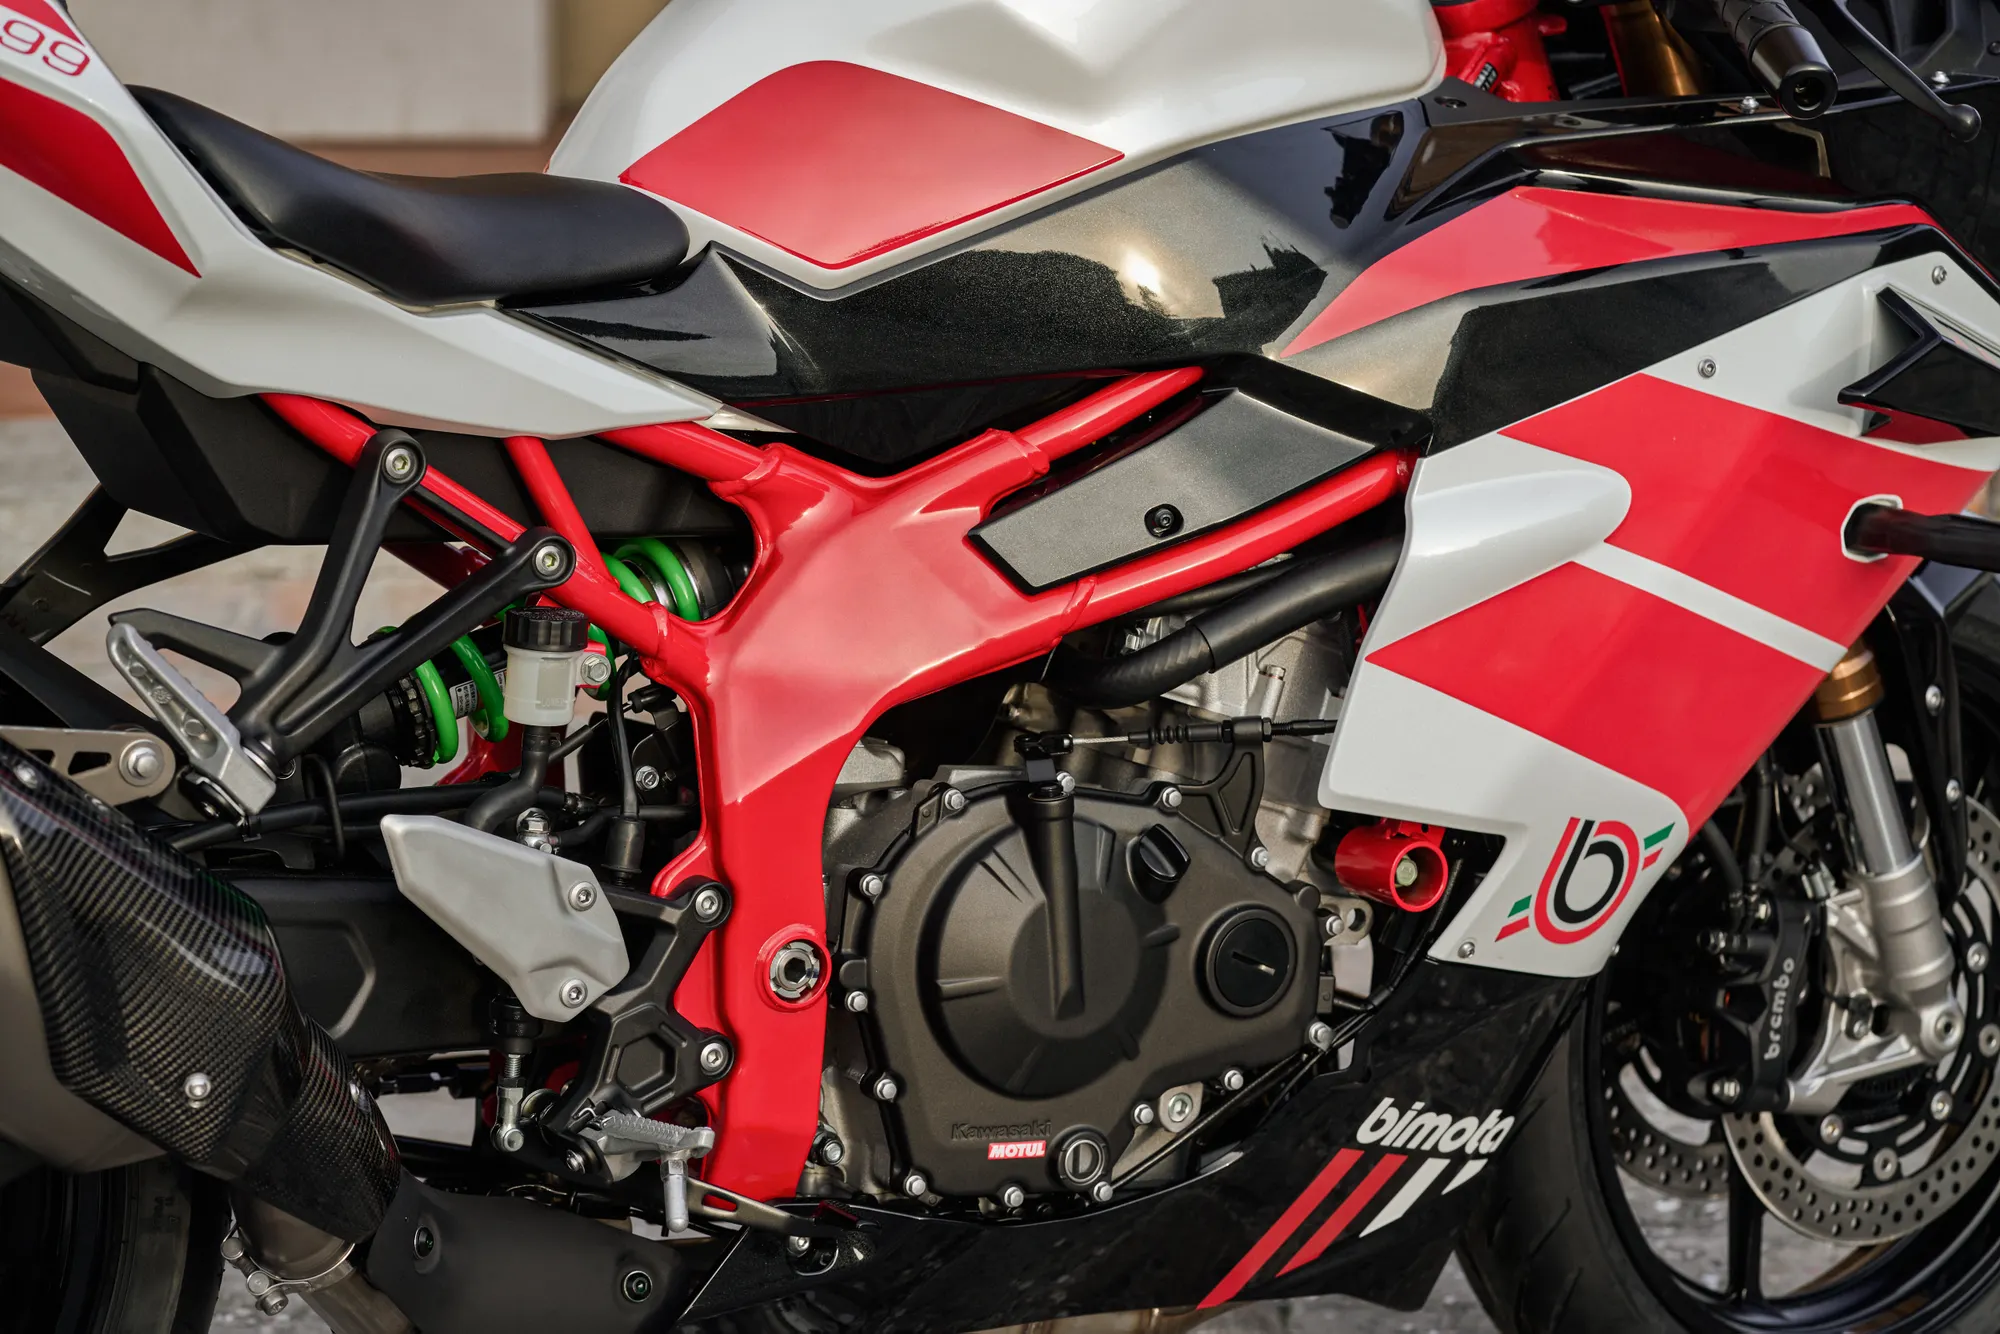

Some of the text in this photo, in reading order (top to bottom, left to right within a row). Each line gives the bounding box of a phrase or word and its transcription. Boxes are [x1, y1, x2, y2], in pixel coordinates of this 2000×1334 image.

[1763, 957, 1795, 1060] brembo
[951, 1119, 1051, 1141] Kawasaki
[1356, 1096, 1515, 1154] bimota
[989, 1142, 1045, 1158] MOTUL
